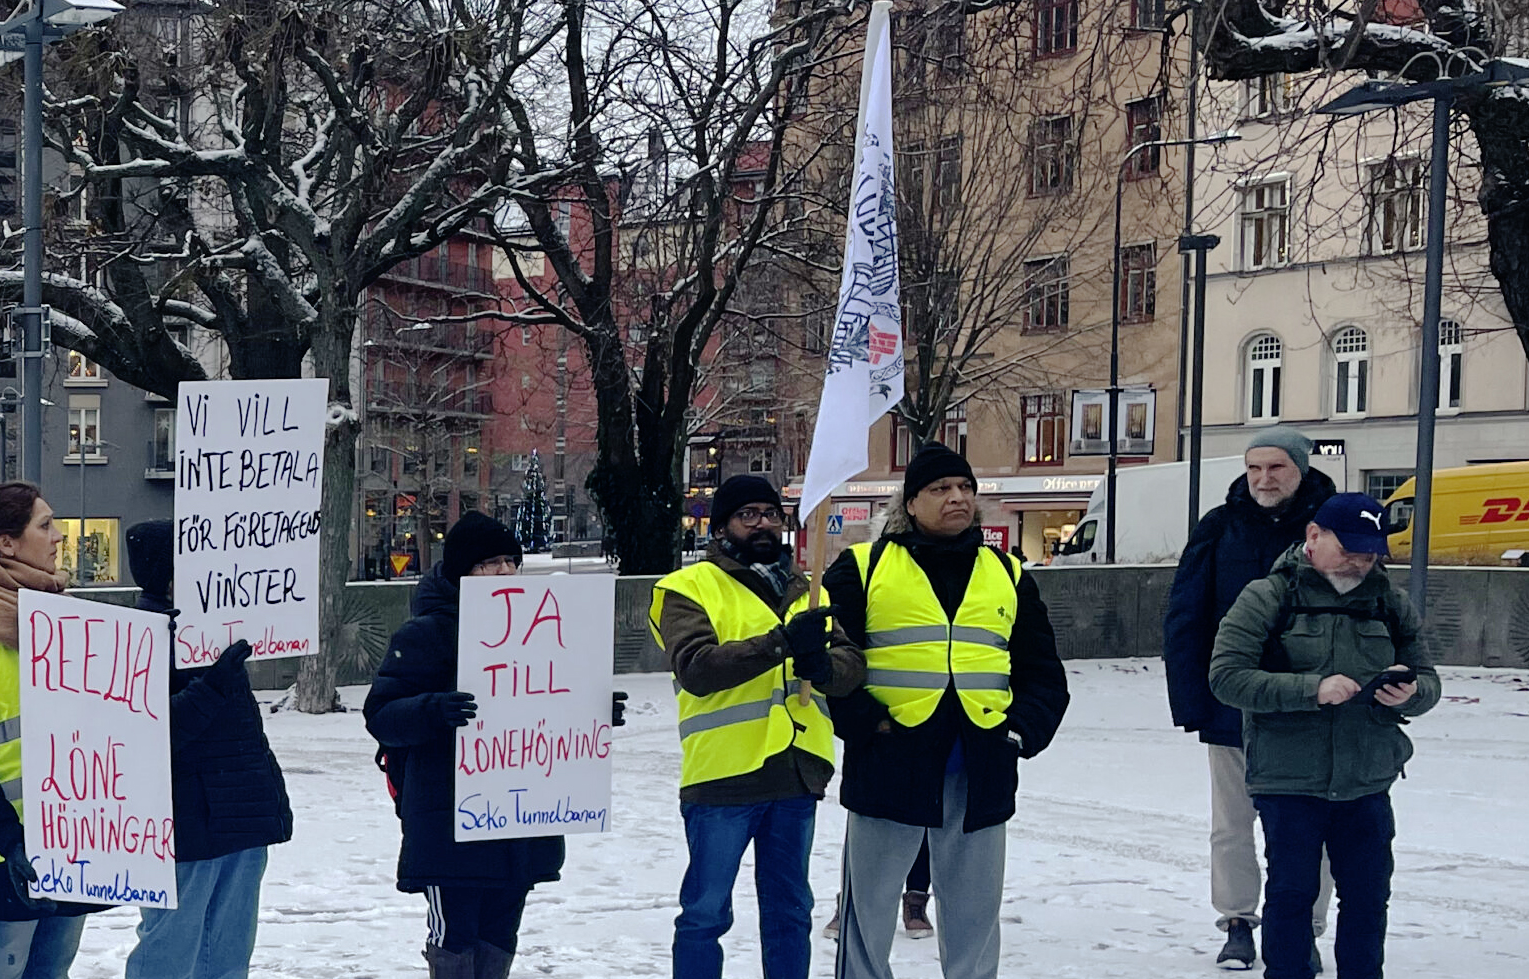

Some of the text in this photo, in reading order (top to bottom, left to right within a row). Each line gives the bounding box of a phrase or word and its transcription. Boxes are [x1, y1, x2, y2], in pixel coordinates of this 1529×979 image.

[239, 449, 319, 491] BETALA
[1042, 478, 1077, 490] Office
[178, 514, 217, 555] FÖR
[480, 588, 566, 649] JA
[41, 730, 126, 800] LÖNE
[508, 788, 606, 832] Tunnelbanan
[72, 860, 167, 908] Tunnelbanan
